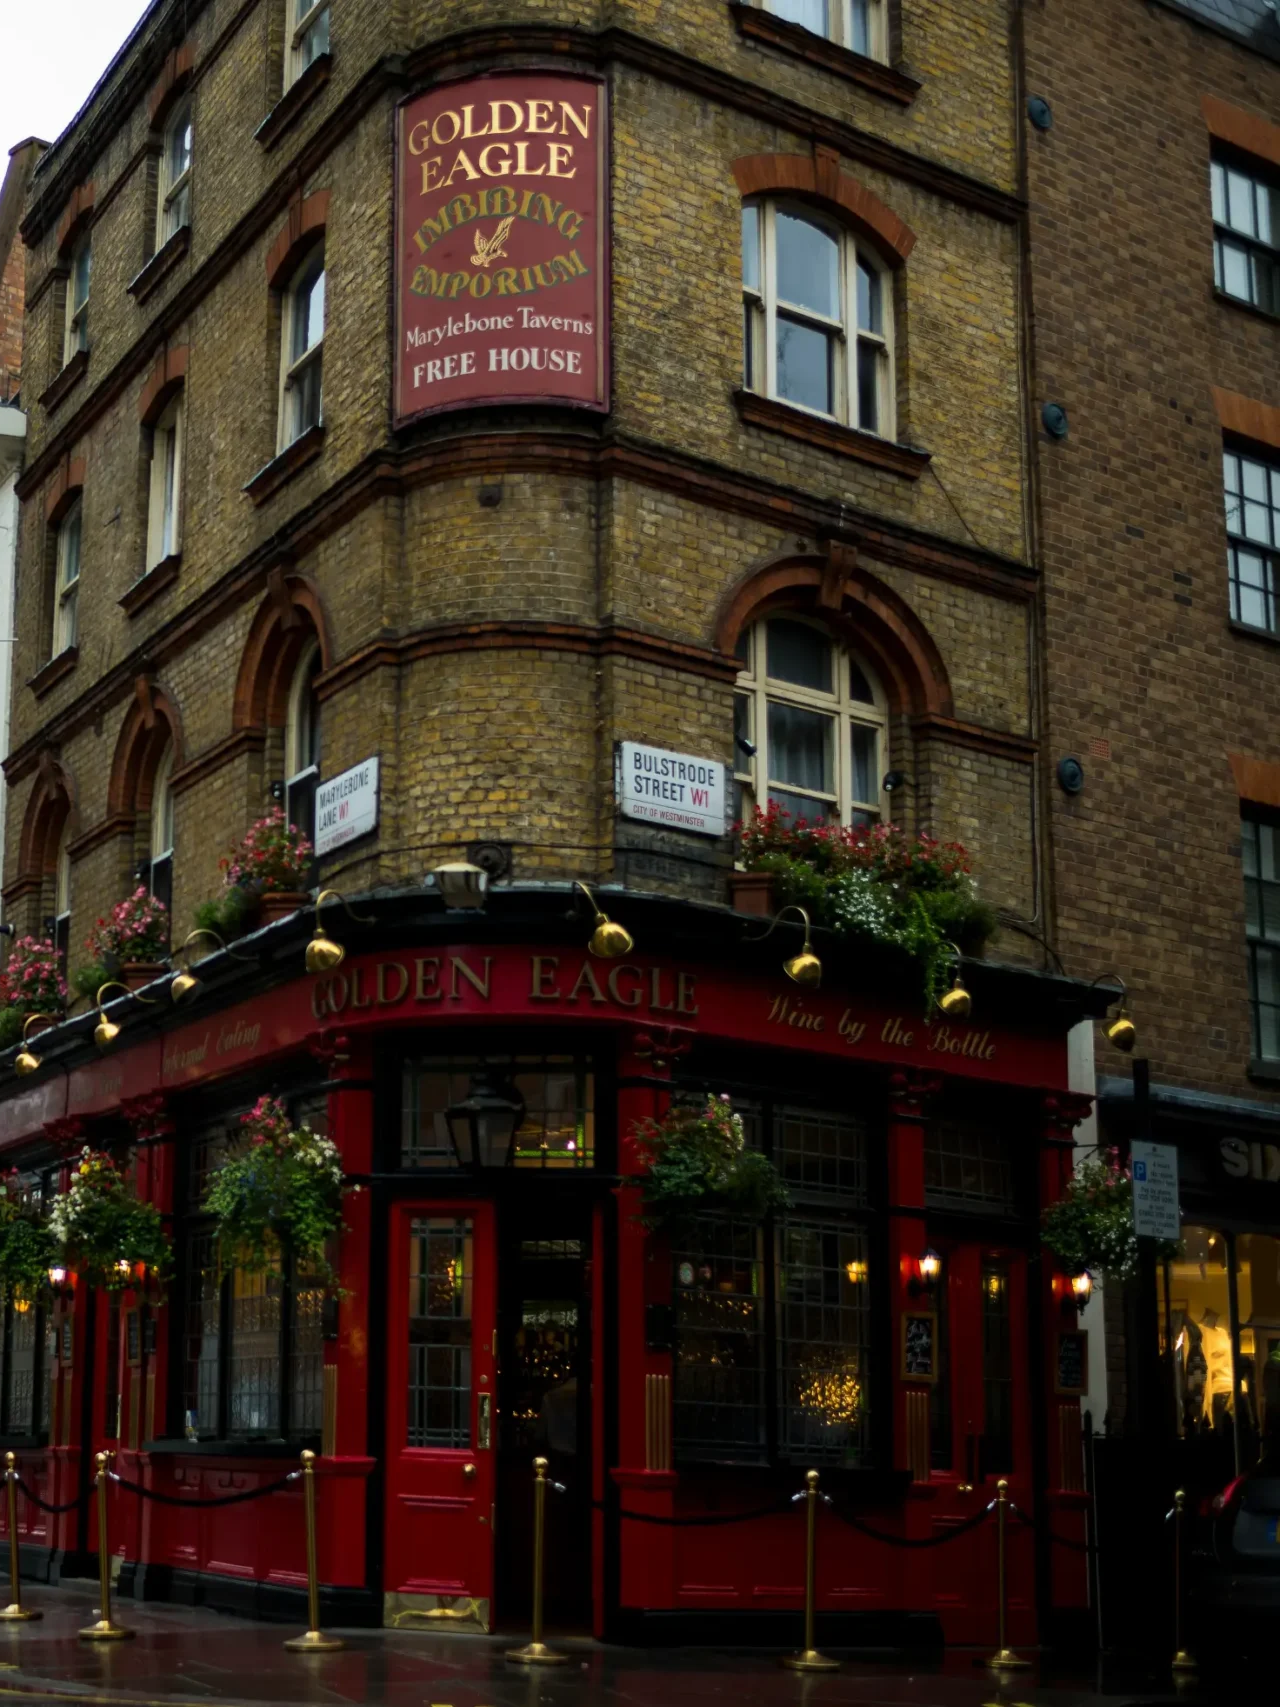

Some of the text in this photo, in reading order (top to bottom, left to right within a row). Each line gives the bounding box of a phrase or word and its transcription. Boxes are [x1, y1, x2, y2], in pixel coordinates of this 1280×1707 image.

[407, 99, 592, 156] GOLDEN
[419, 141, 577, 196] EAGLE
[412, 185, 586, 256] IMBIBING
[409, 249, 591, 300] EMPORIUM
[406, 306, 593, 352] Marylebone Taverns
[412, 347, 583, 389] FREE HOUSE
[319, 766, 370, 809] MARYLEBONE
[633, 751, 715, 787] BULSTRODE
[634, 774, 709, 808] STREET W1
[318, 800, 349, 832] LANE W1
[633, 804, 705, 828] CITY OF WESTMINSTER
[310, 954, 699, 1019] GOLDEN EAGLE
[767, 993, 997, 1060] Wine by the Bottle
